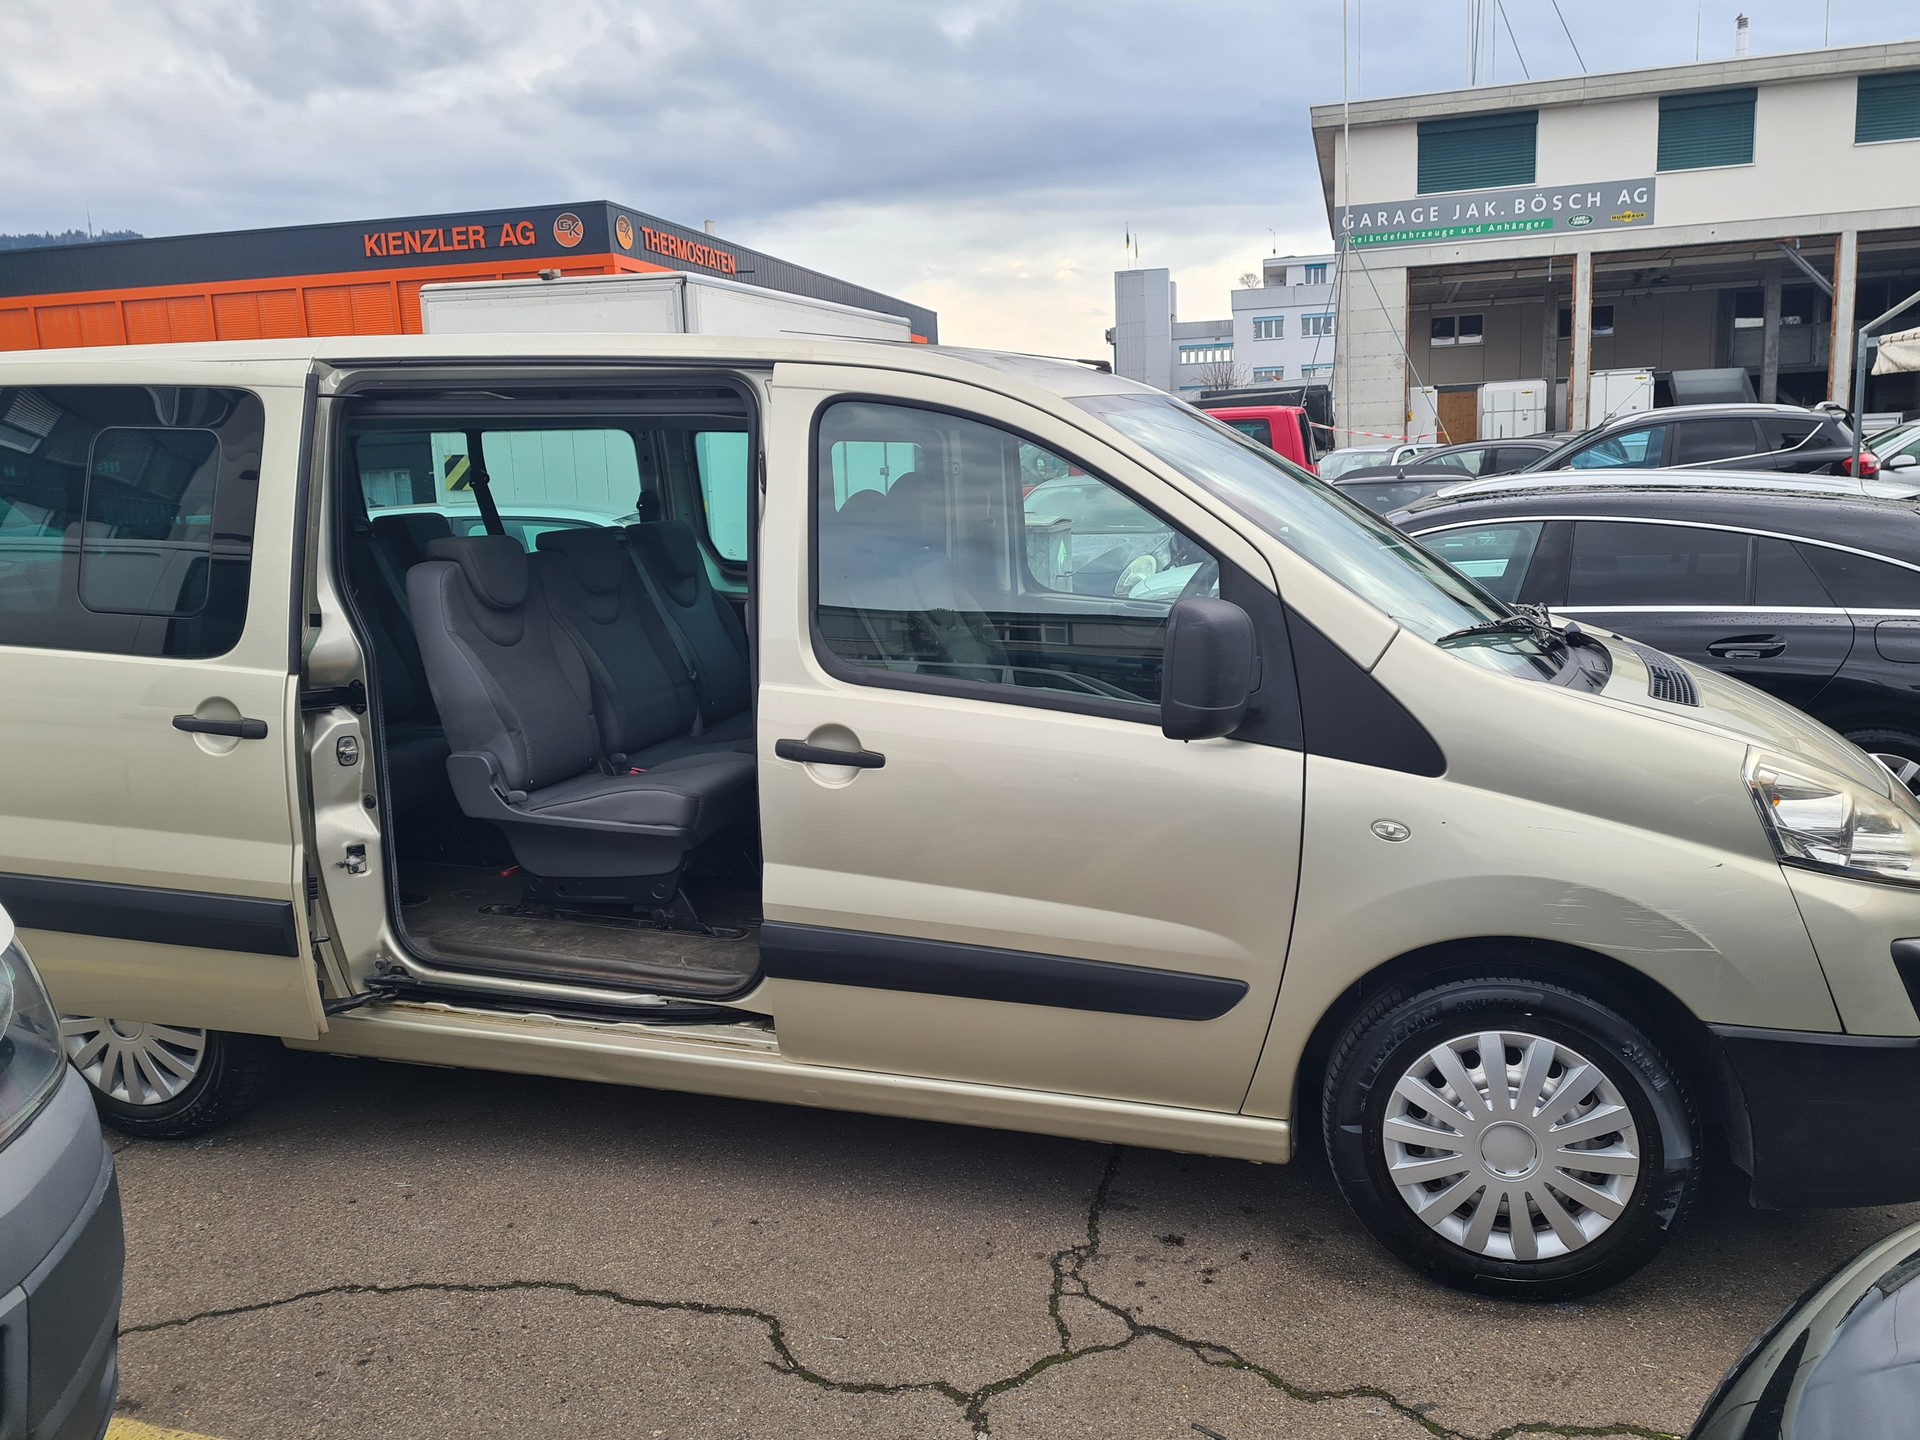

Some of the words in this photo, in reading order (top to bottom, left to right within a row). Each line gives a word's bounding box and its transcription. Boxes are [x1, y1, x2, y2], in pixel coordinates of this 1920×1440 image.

[1341, 206, 1439, 229] GARAGE
[1452, 200, 1505, 220] JAK.
[1514, 191, 1602, 214] BÖSCH
[1617, 187, 1649, 206] AG
[363, 224, 487, 258] KIENZLER
[499, 220, 536, 248] AG
[640, 225, 736, 276] THERMOSTATEN
[1349, 227, 1455, 244] Geländefahrzeuge
[1461, 224, 1483, 235] und
[1488, 219, 1546, 232] Anhänger
